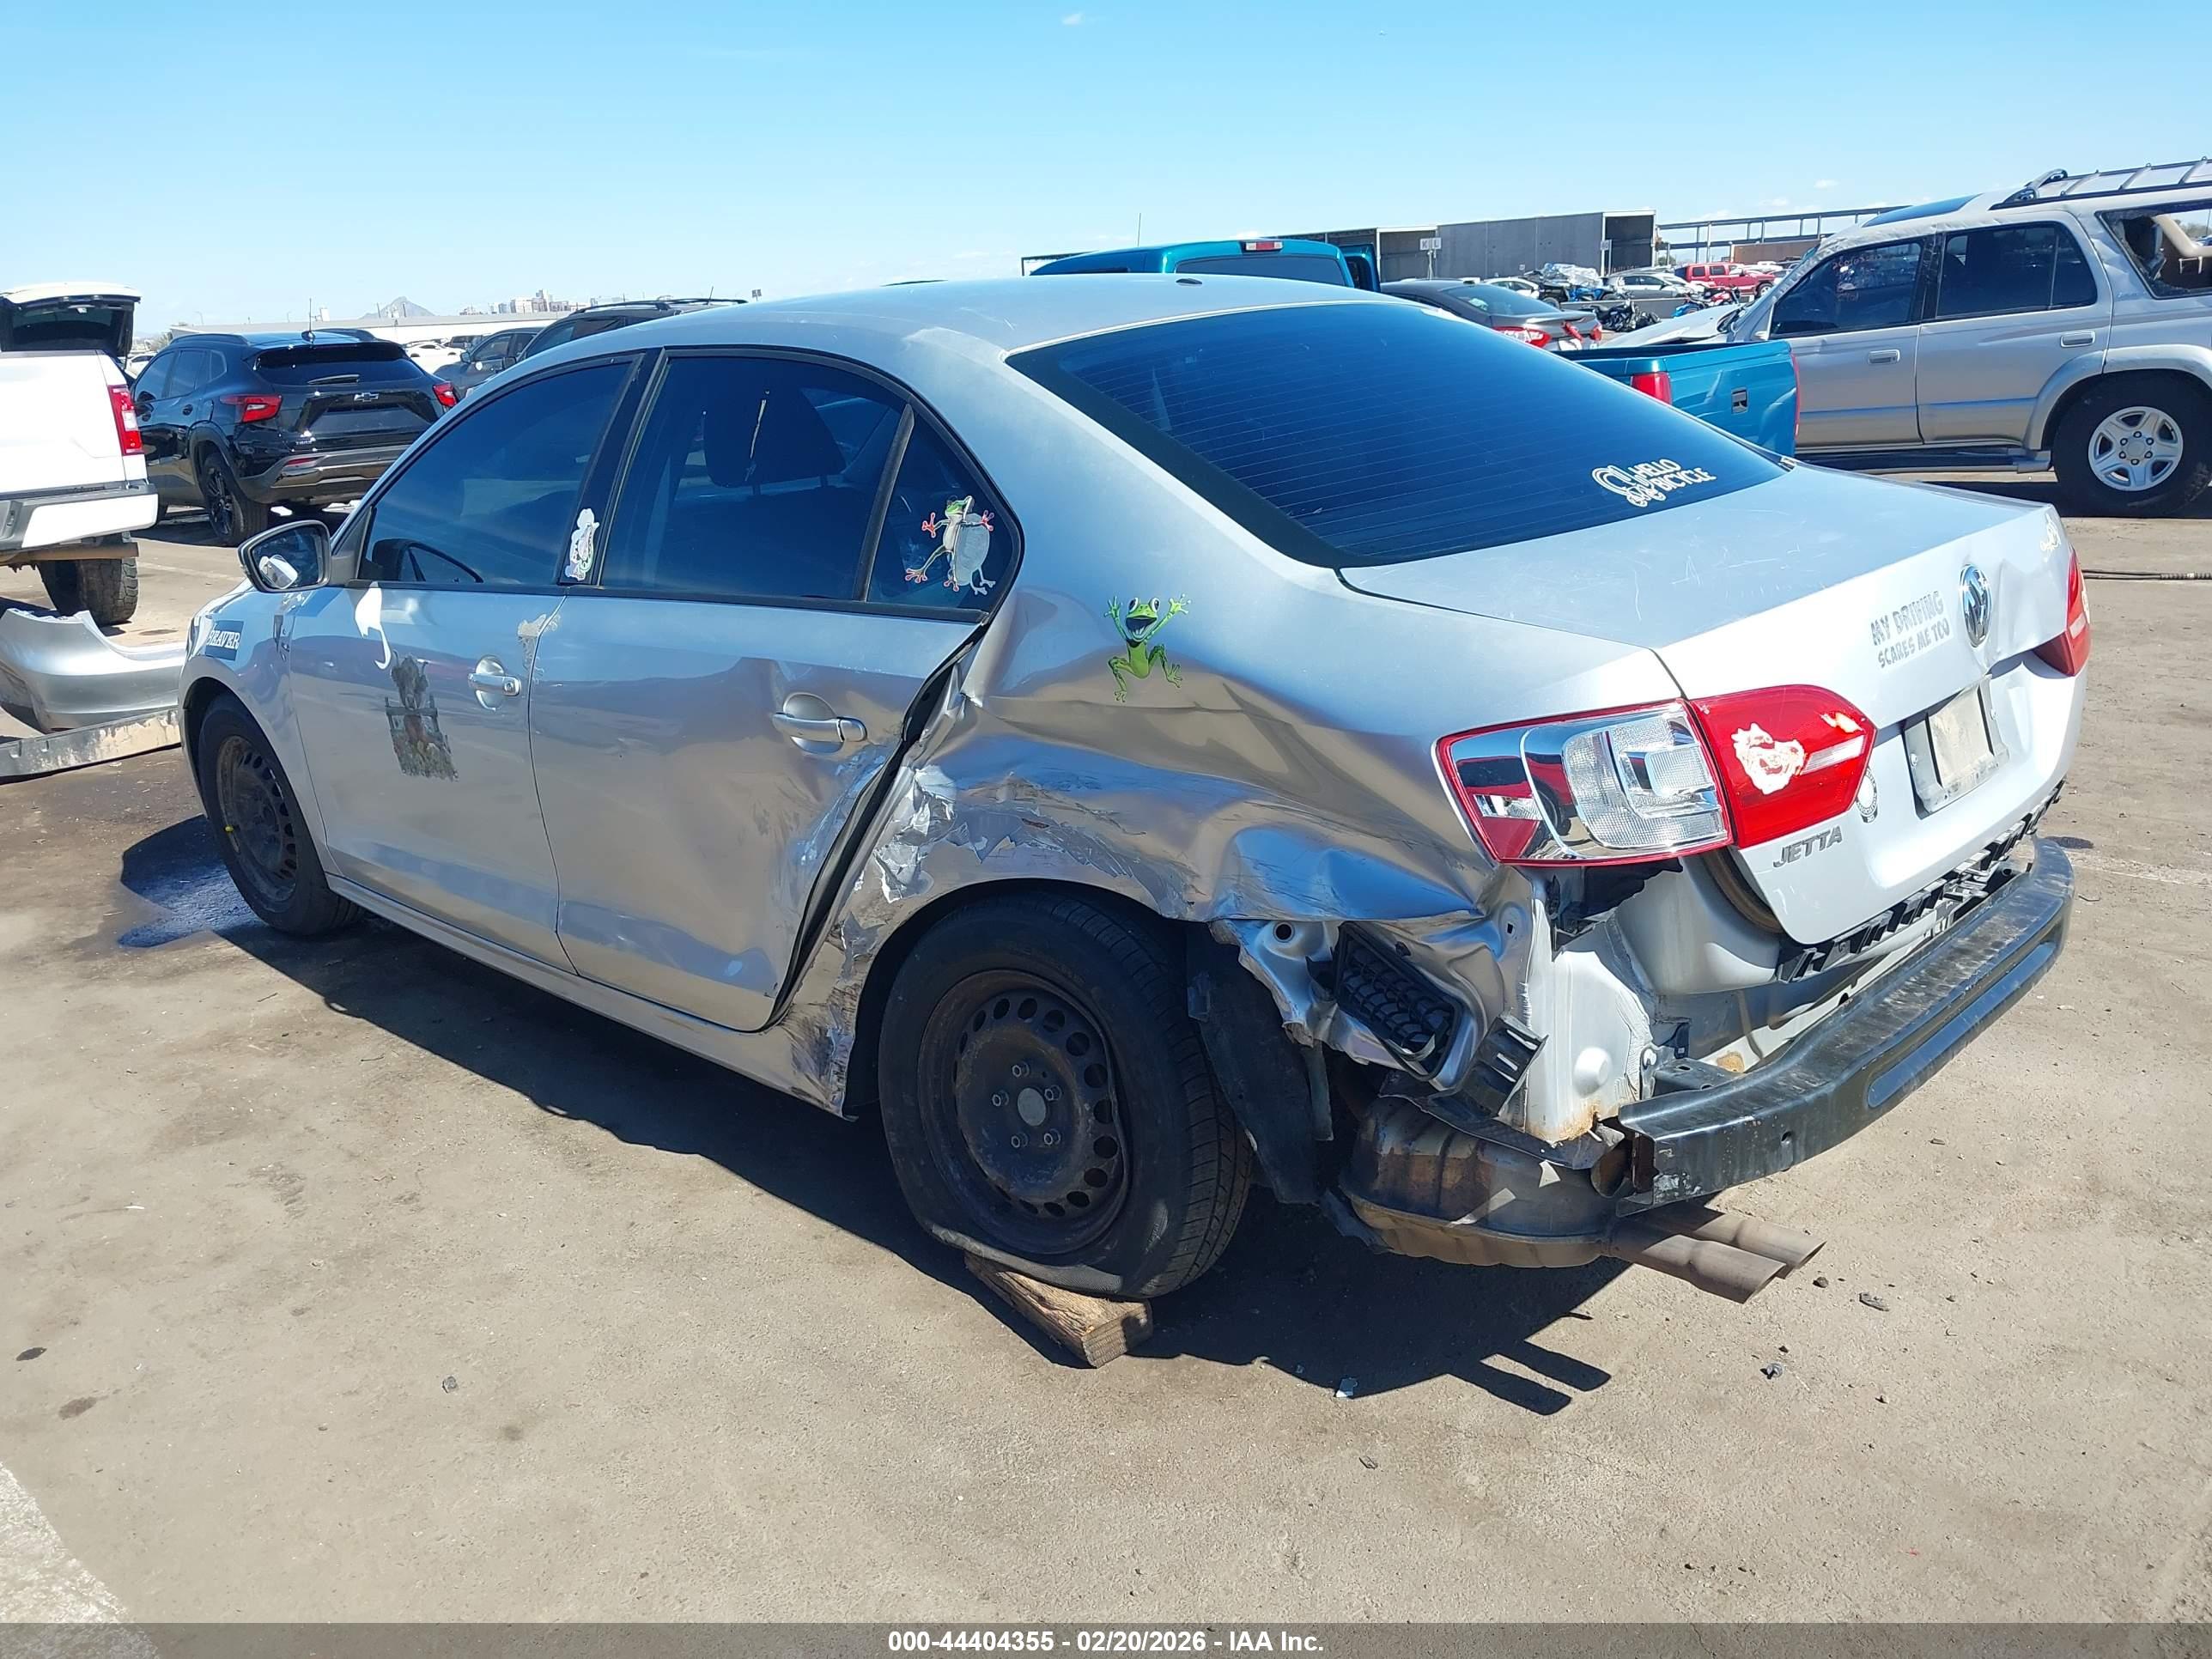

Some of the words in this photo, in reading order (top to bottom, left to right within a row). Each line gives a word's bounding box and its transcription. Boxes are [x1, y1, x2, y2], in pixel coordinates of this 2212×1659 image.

[1628, 458, 1681, 478] HELLO
[1650, 467, 1717, 492] BICYCLE
[1870, 615, 1890, 646] MY
[1892, 590, 1943, 635] DRIVING
[1878, 636, 1916, 669] SCARES
[1916, 628, 1932, 650] ME
[1930, 617, 1950, 641] TOO
[1772, 825, 1843, 868] JETTA
